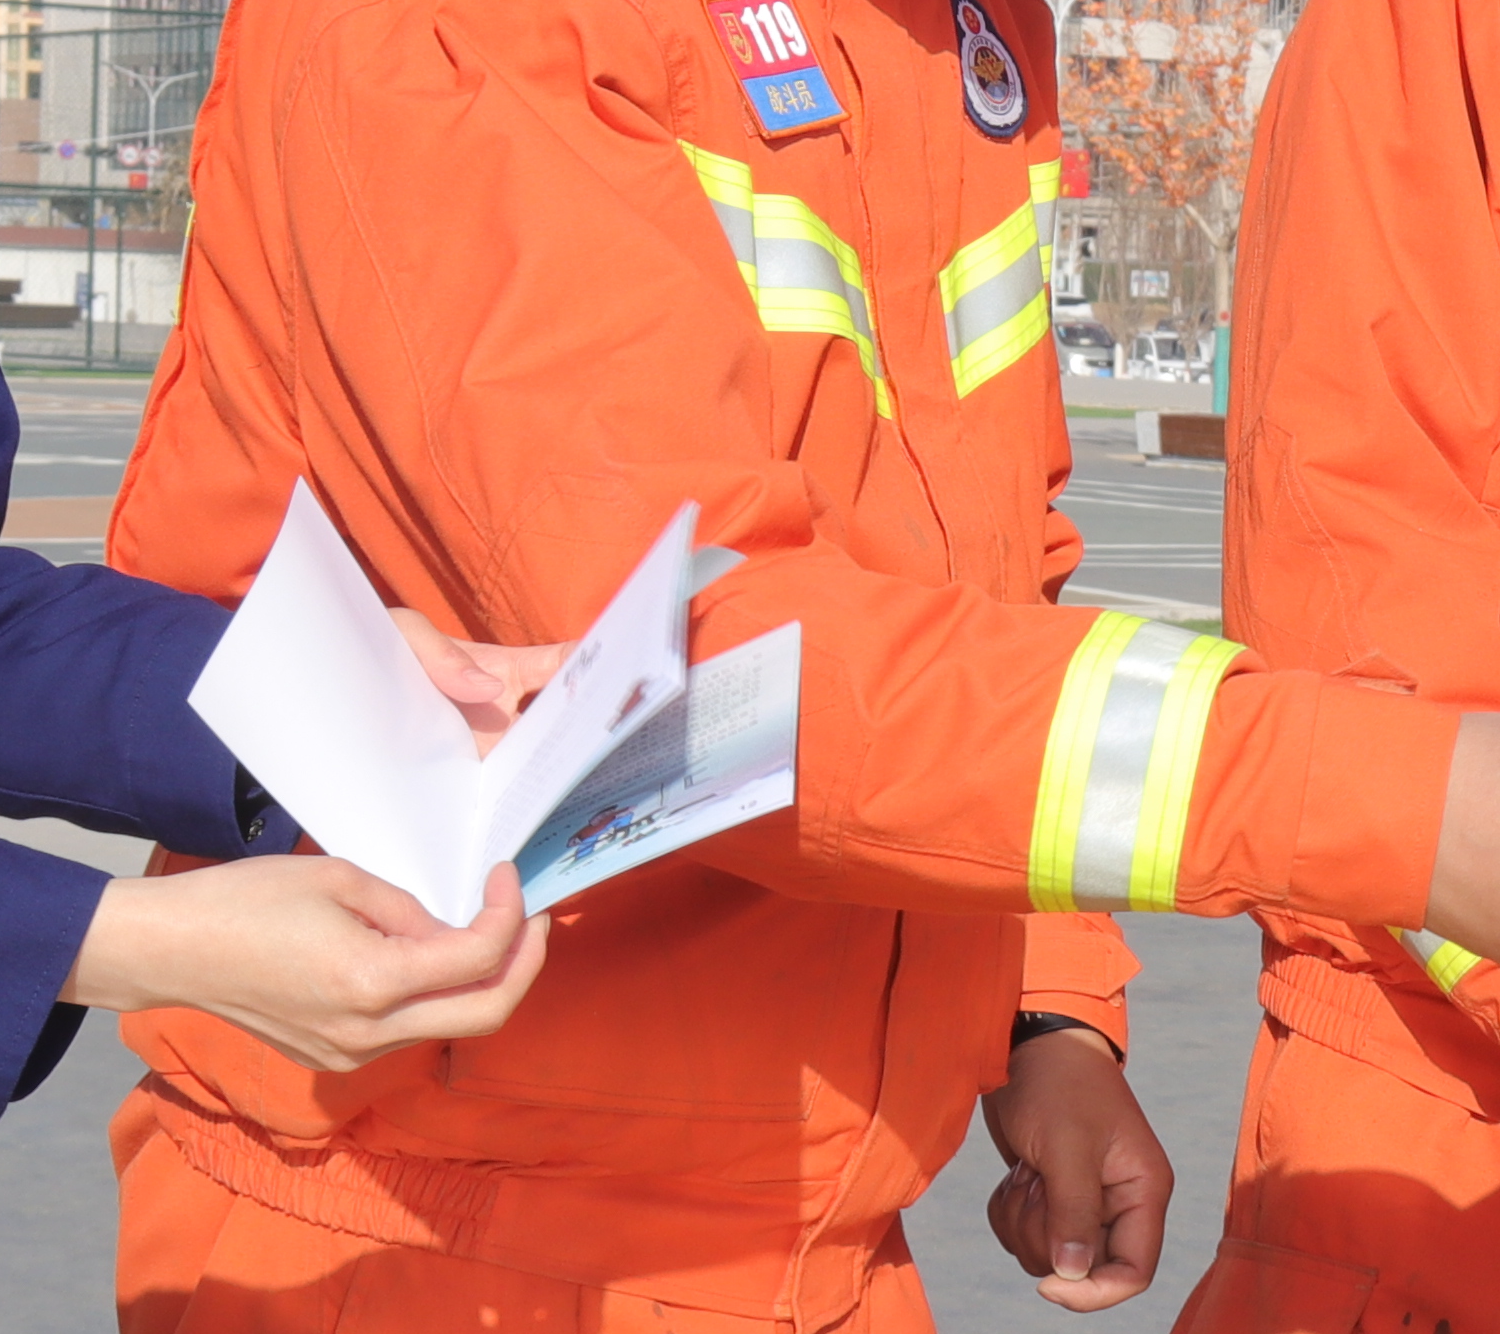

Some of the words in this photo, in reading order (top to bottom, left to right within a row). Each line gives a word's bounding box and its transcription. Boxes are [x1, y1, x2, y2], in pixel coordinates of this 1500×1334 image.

[740, 1, 808, 64] 119
[766, 79, 817, 116] 战斗员
